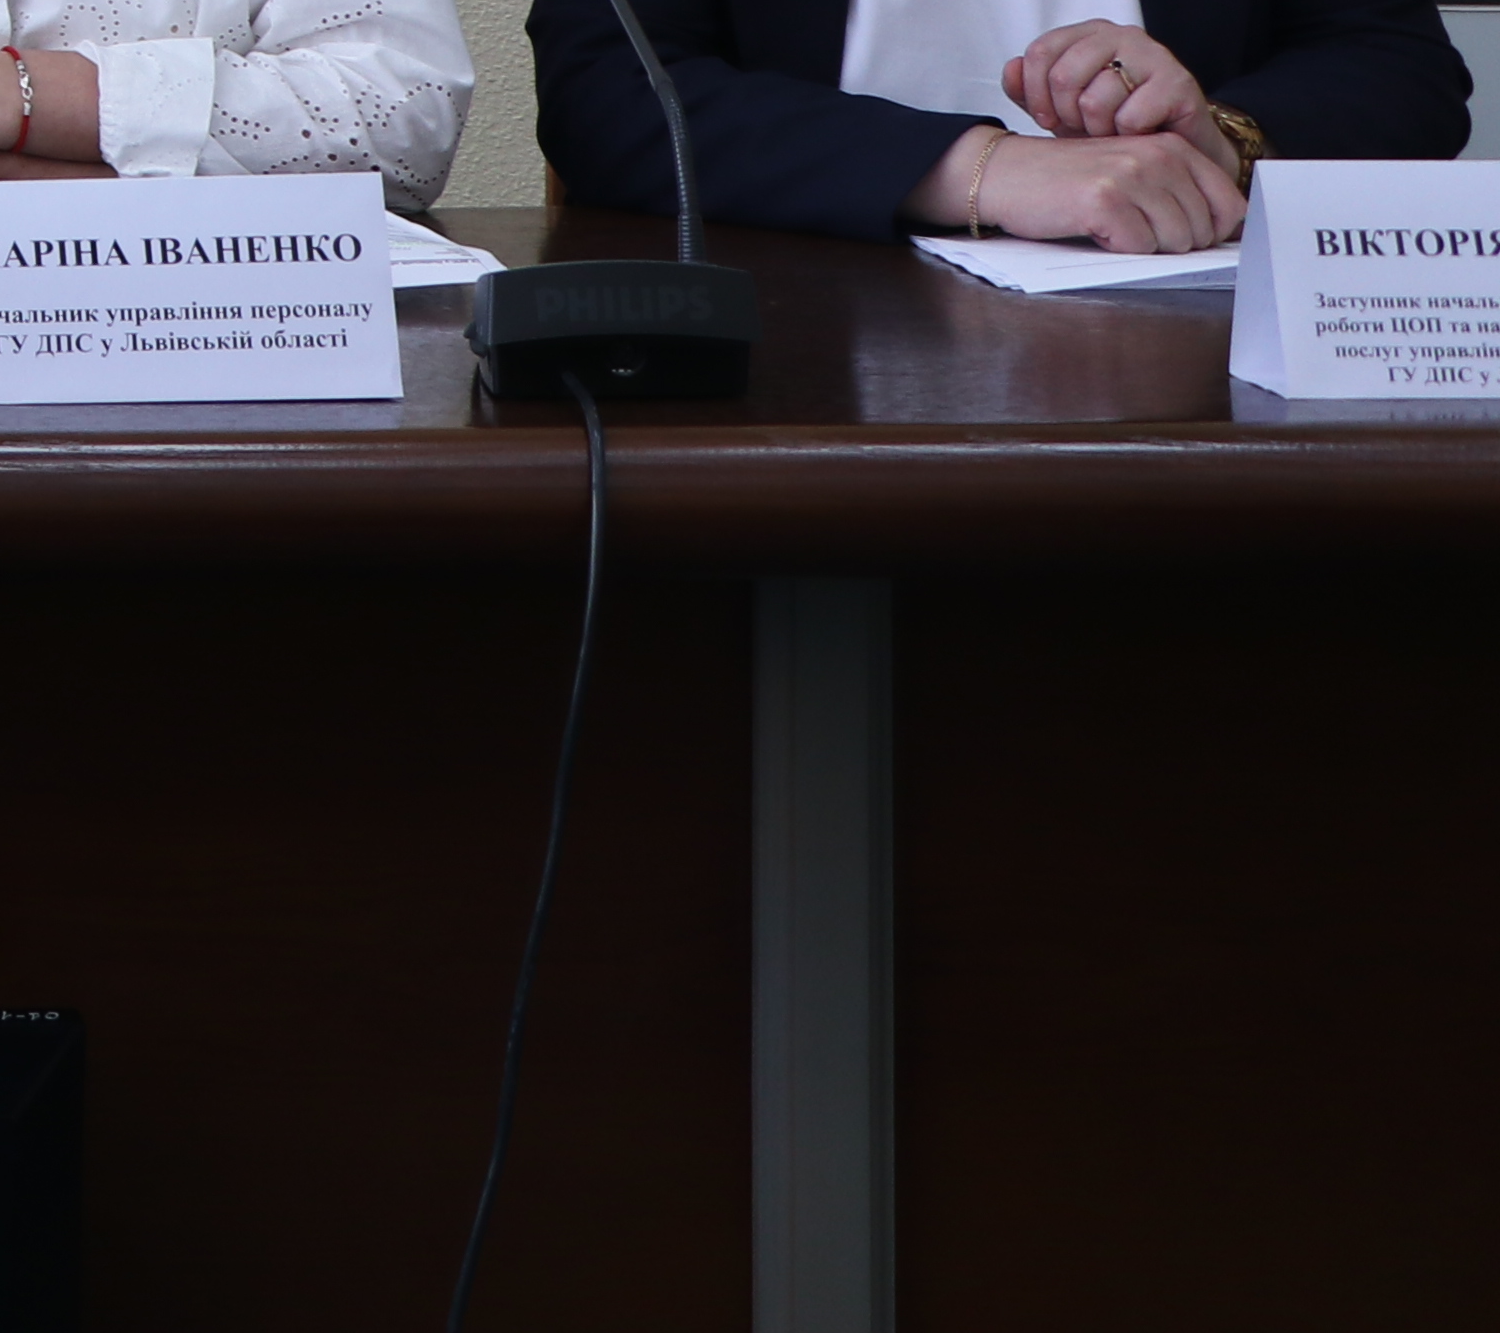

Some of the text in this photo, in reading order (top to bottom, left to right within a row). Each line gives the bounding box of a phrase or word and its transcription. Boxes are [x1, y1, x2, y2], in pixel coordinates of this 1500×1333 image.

[142, 233, 362, 266] ІВАНЕНКО
[105, 301, 243, 328] управління
[250, 303, 373, 324] персоналу
[536, 285, 713, 322] PHILIPS
[1315, 292, 1421, 313] Заступник
[1315, 316, 1385, 338] роботи
[1390, 316, 1442, 336] ЦОП
[1450, 321, 1472, 334] та
[35, 333, 93, 357] ДПС
[100, 338, 113, 358] у
[120, 331, 253, 352] Львівській
[260, 329, 348, 349] області
[1335, 346, 1403, 362] послуг
[1387, 366, 1417, 383] ГУ
[1424, 366, 1472, 385] ДПС
[1479, 370, 1490, 388] у
